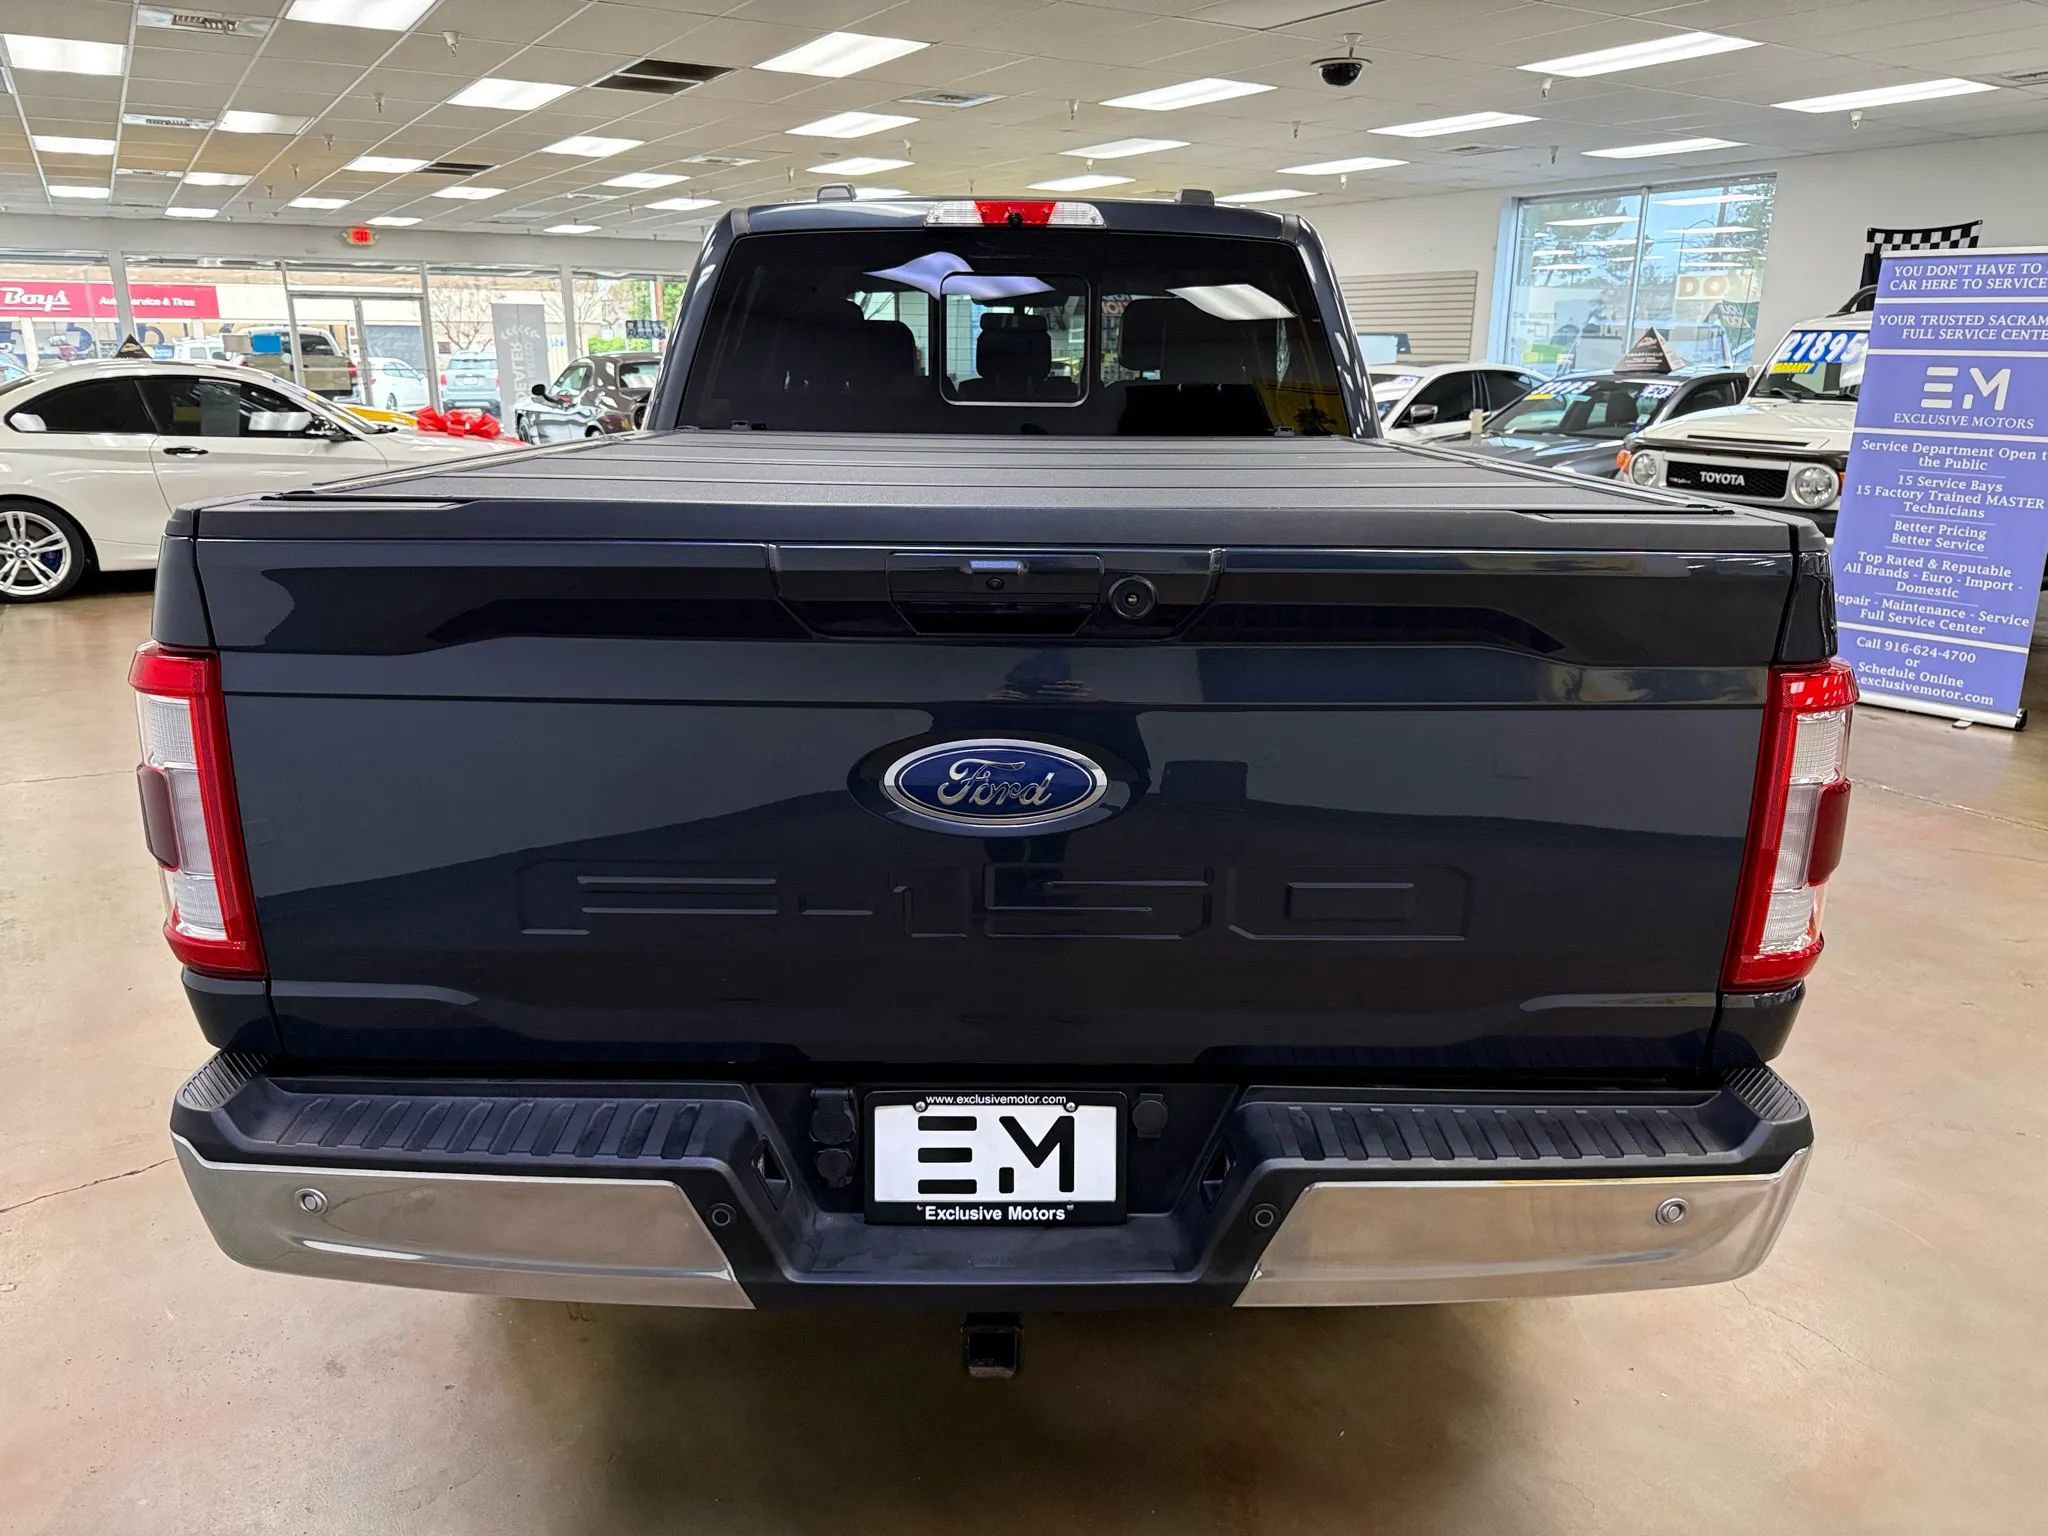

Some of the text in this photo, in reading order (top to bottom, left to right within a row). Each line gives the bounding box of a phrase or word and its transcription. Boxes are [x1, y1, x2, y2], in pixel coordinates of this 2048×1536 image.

[1894, 265, 1922, 277] YOU
[1926, 264, 1972, 276] DON'T
[1975, 263, 2016, 276] HAVE
[2020, 263, 2042, 275] TO
[1890, 277, 2047, 291] CAR HERE TO SERVICE
[0, 287, 71, 312] Boys
[99, 296, 197, 307] Aut ervice & Tires
[1879, 314, 1915, 326] YOUR
[1920, 314, 1985, 326] TRUSTED
[1902, 328, 1935, 340] FULL
[1938, 329, 1997, 340] SERVICE
[1893, 412, 2035, 430] EXCLUSIVE MOTORS
[1861, 439, 1908, 453] Service
[1912, 442, 1994, 458] Department
[1999, 447, 2037, 461] Open
[1918, 456, 1988, 471] the Public
[1700, 471, 1745, 486] TOYOTA
[1898, 474, 2003, 494] 15 Service Bays
[1856, 484, 2046, 510] 15 Factory Trained MASTER
[1903, 501, 1985, 518] Technicians
[1894, 520, 1988, 541] Better Pricing
[1891, 533, 1985, 552] Better Service
[1857, 551, 2012, 578] Top Rated & Reputable
[1843, 562, 1862, 575] All
[1864, 564, 1910, 580] Brands
[1920, 571, 1953, 585] Euro
[1964, 576, 2014, 592] Import
[1895, 581, 1960, 599] Domestic
[1860, 608, 1987, 635] Full Service Center
[1882, 598, 1966, 619] Maintenance
[1977, 610, 2030, 628] Service
[1856, 636, 1977, 664] Call 916-624-4700
[1904, 657, 1920, 668] or
[1858, 661, 1965, 688] Schedule Online
[937, 758, 1055, 806] Ford
[925, 1094, 1067, 1105] www.exclusivemotor.com
[917, 1115, 1075, 1194] EM
[925, 1205, 1066, 1221] Exclusive Motors
